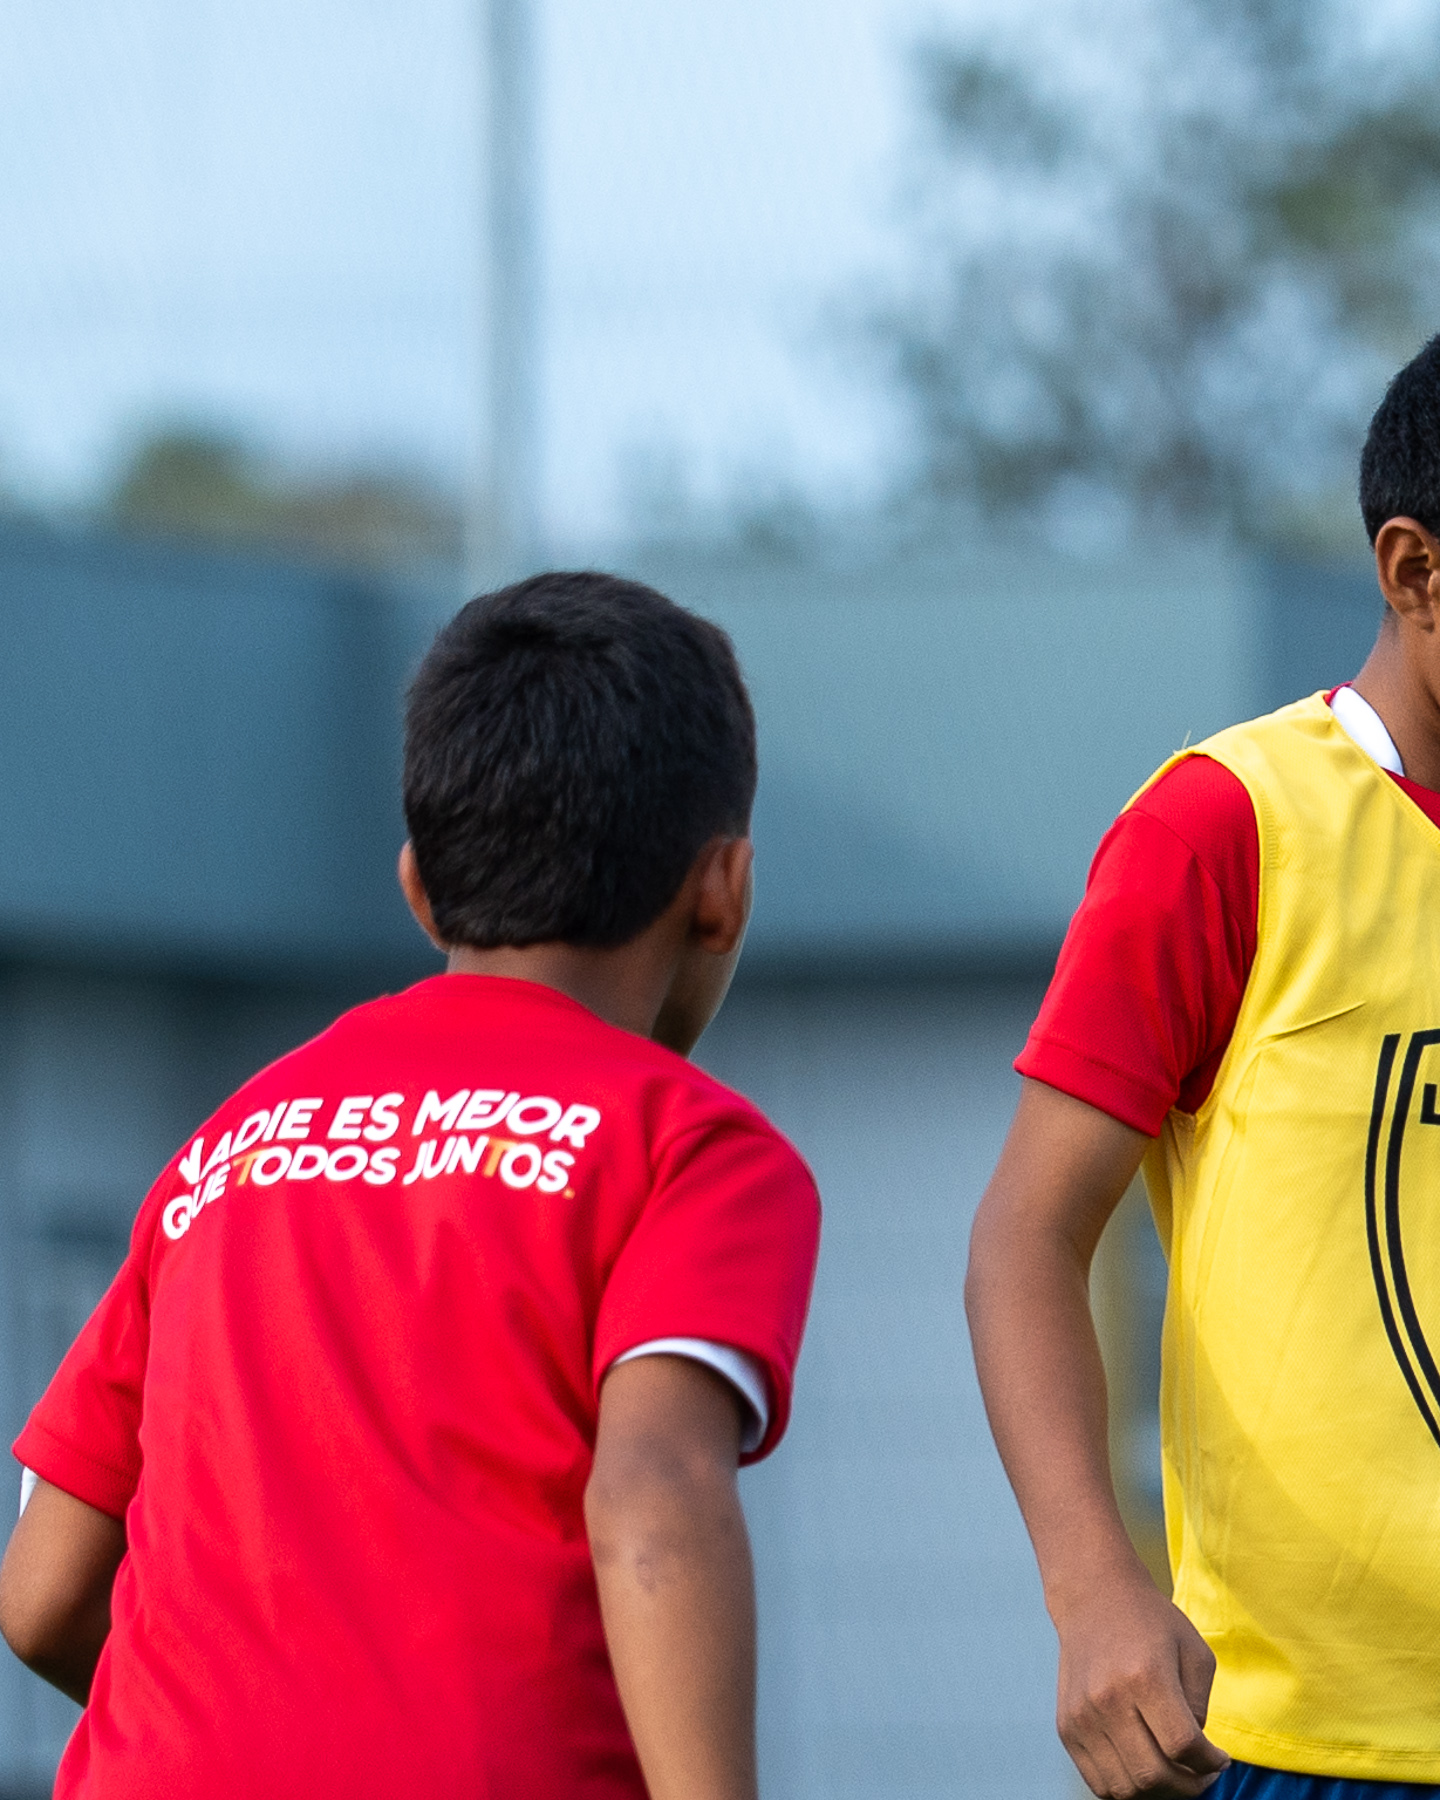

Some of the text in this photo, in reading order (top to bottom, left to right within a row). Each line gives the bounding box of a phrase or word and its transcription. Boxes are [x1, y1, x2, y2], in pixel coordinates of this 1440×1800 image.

[327, 1093, 405, 1141] ES
[412, 1088, 601, 1148] MEJOR
[162, 1163, 231, 1240] QUE
[232, 1145, 401, 1186] TODOS
